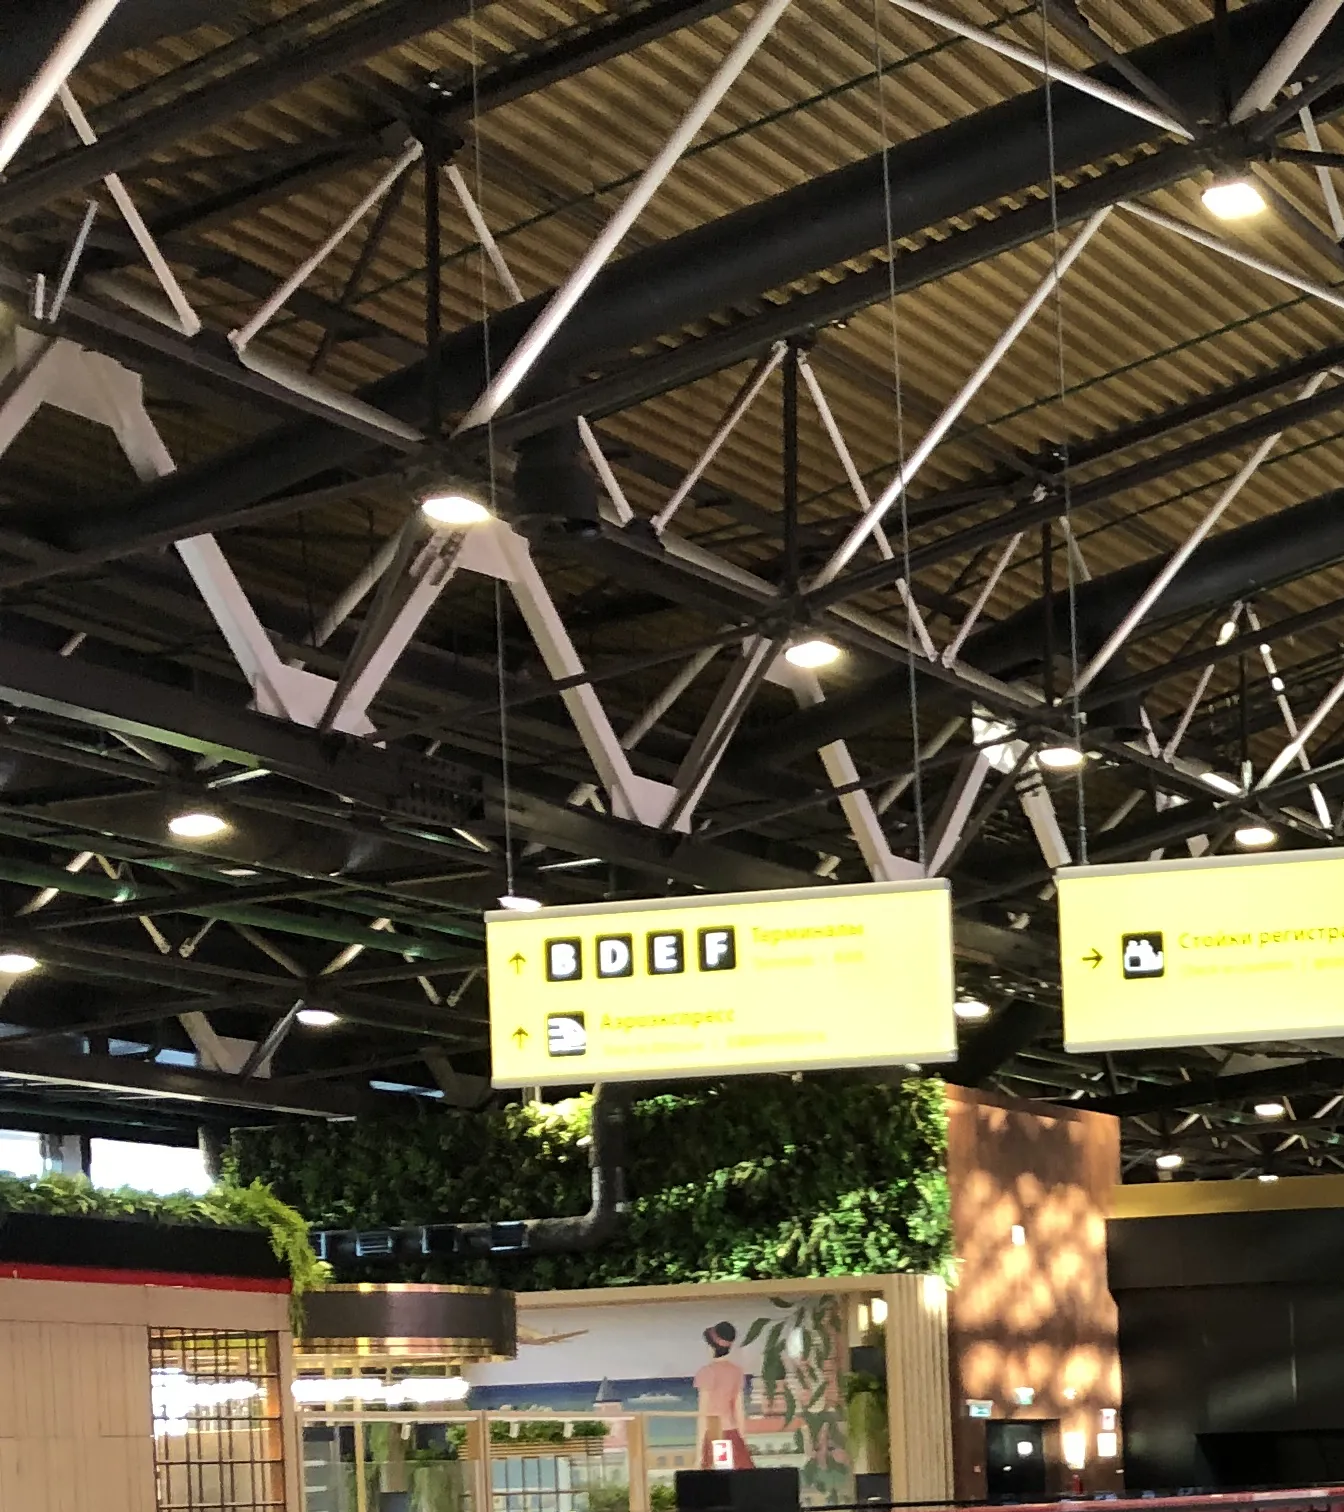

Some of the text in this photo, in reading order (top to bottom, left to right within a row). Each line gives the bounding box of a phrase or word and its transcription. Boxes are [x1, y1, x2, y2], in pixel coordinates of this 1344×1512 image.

[550, 942, 577, 976] B
[599, 939, 630, 973] D
[653, 935, 678, 971] E
[705, 931, 729, 968] F
[1177, 929, 1253, 949] Стойки
